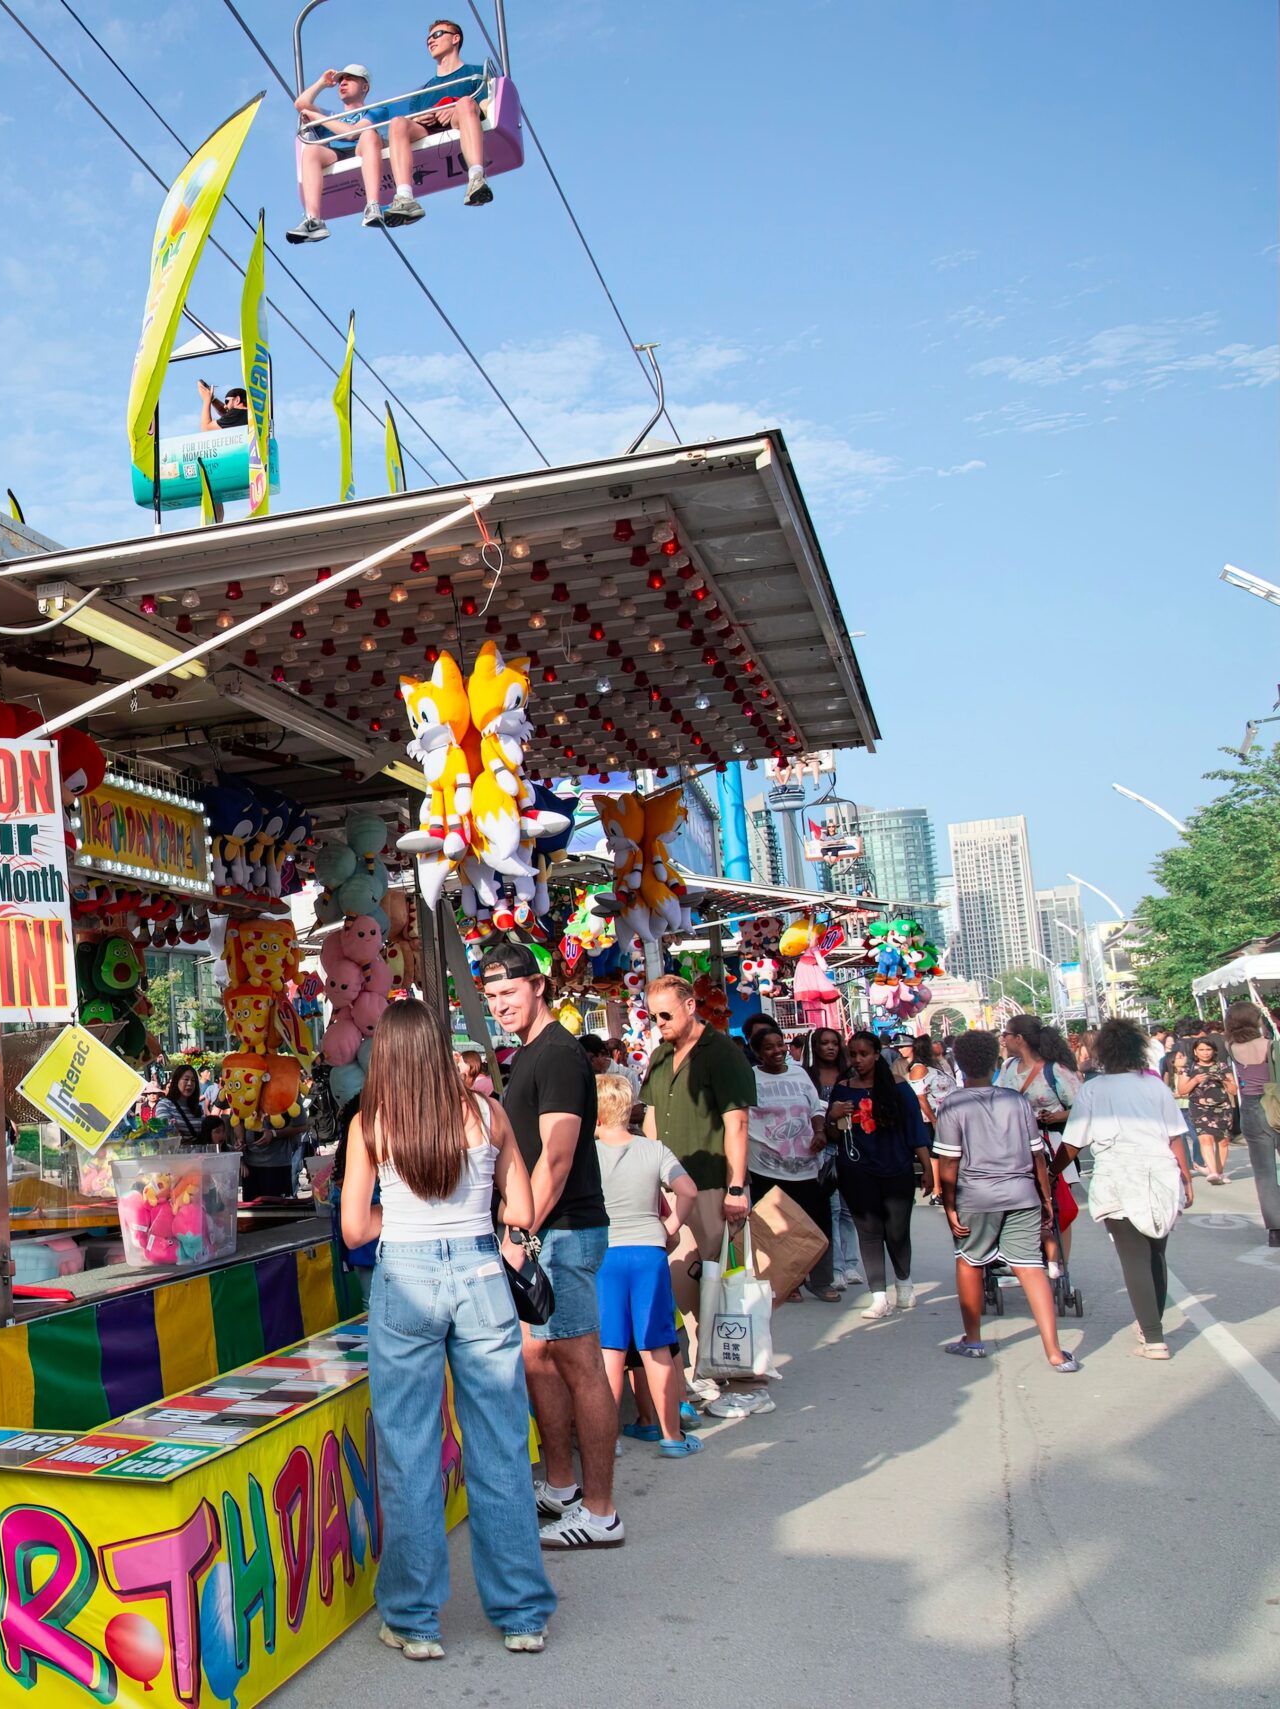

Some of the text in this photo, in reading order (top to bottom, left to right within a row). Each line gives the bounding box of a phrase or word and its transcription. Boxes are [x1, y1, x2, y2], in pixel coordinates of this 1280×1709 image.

[47, 1039, 91, 1123] Interac
[4, 1434, 75, 1452] DEC
[46, 1443, 131, 1465] XMAS
[140, 1445, 211, 1461] NEW
[111, 1459, 186, 1476] YEAR
